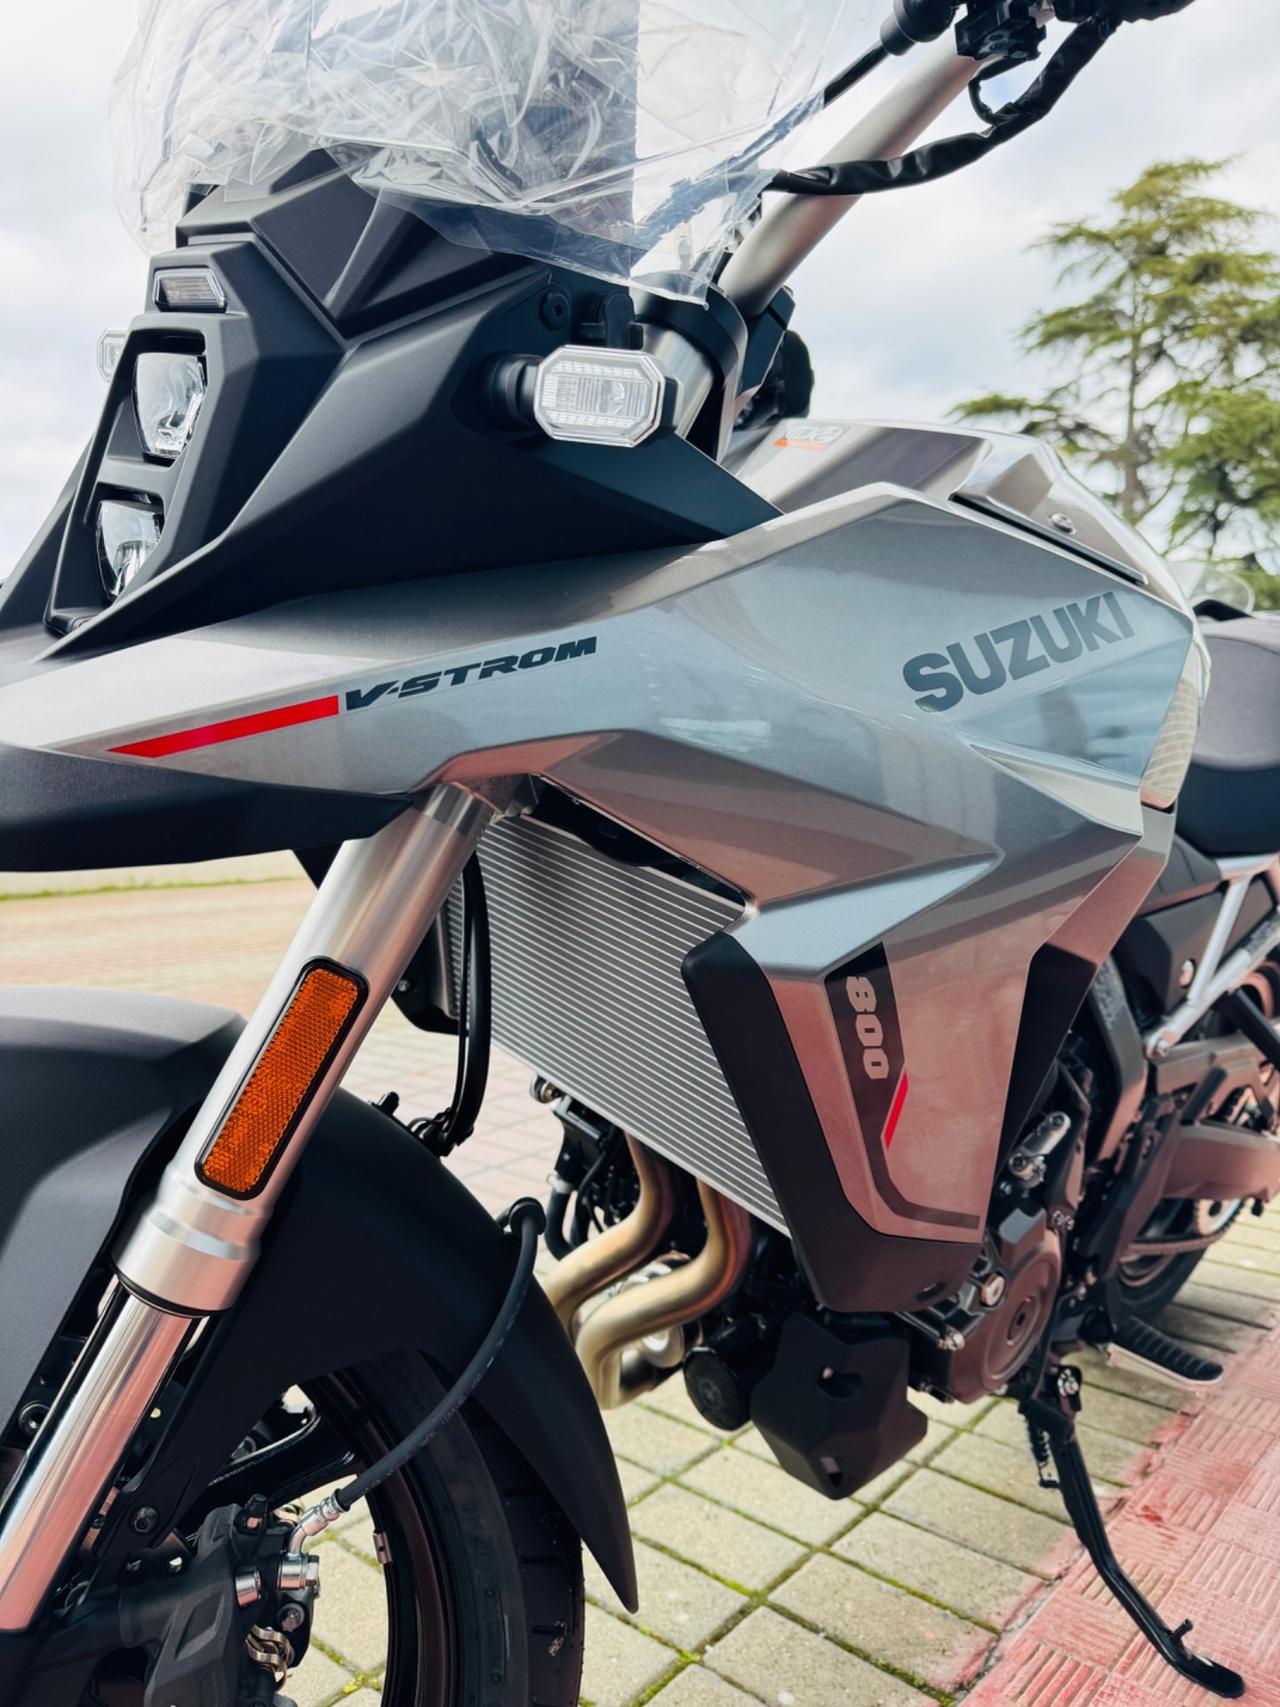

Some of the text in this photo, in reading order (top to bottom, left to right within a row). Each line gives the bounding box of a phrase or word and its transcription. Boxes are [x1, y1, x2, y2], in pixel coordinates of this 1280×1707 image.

[346, 636, 597, 711] V-STROM
[903, 591, 1135, 712] SUZUKI
[845, 976, 889, 1080] 800
